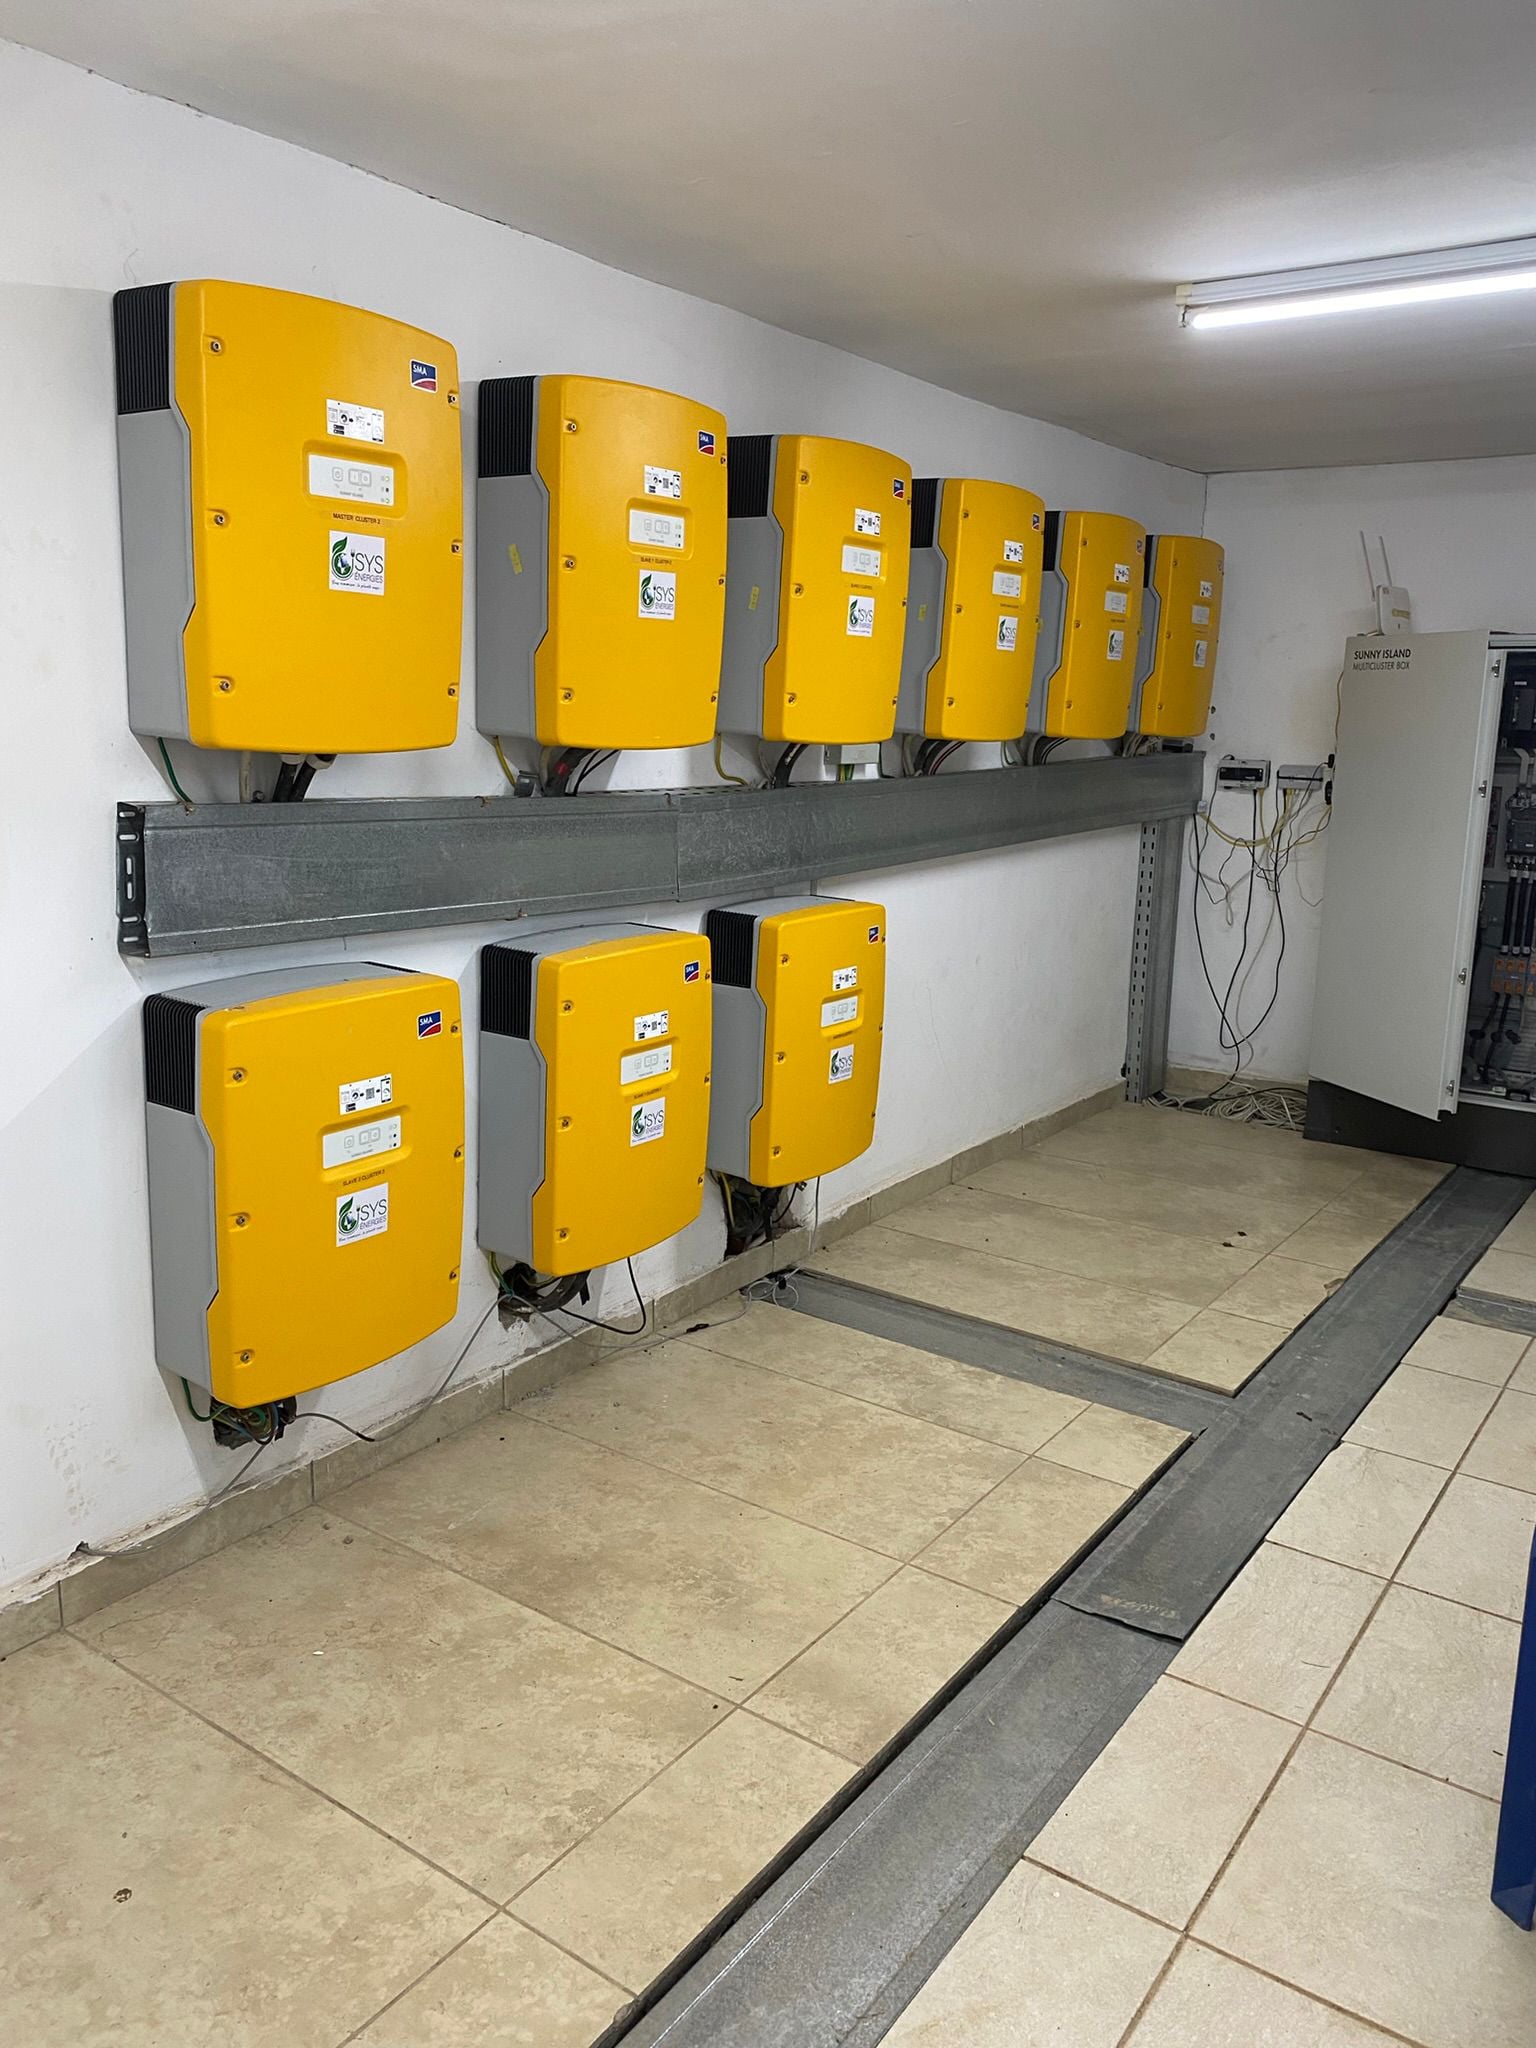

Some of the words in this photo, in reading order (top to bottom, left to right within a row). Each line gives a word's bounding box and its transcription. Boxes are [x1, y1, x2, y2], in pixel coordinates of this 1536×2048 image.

[412, 364, 427, 376] SMA
[333, 512, 354, 521] MASTER
[355, 515, 376, 524] CLUSTER
[1354, 650, 1381, 660] SUNNY
[1382, 648, 1411, 658] ISLAND
[1353, 661, 1395, 671] MULTICLUSTER
[1396, 661, 1410, 670] BOX
[419, 1016, 433, 1026] SMA
